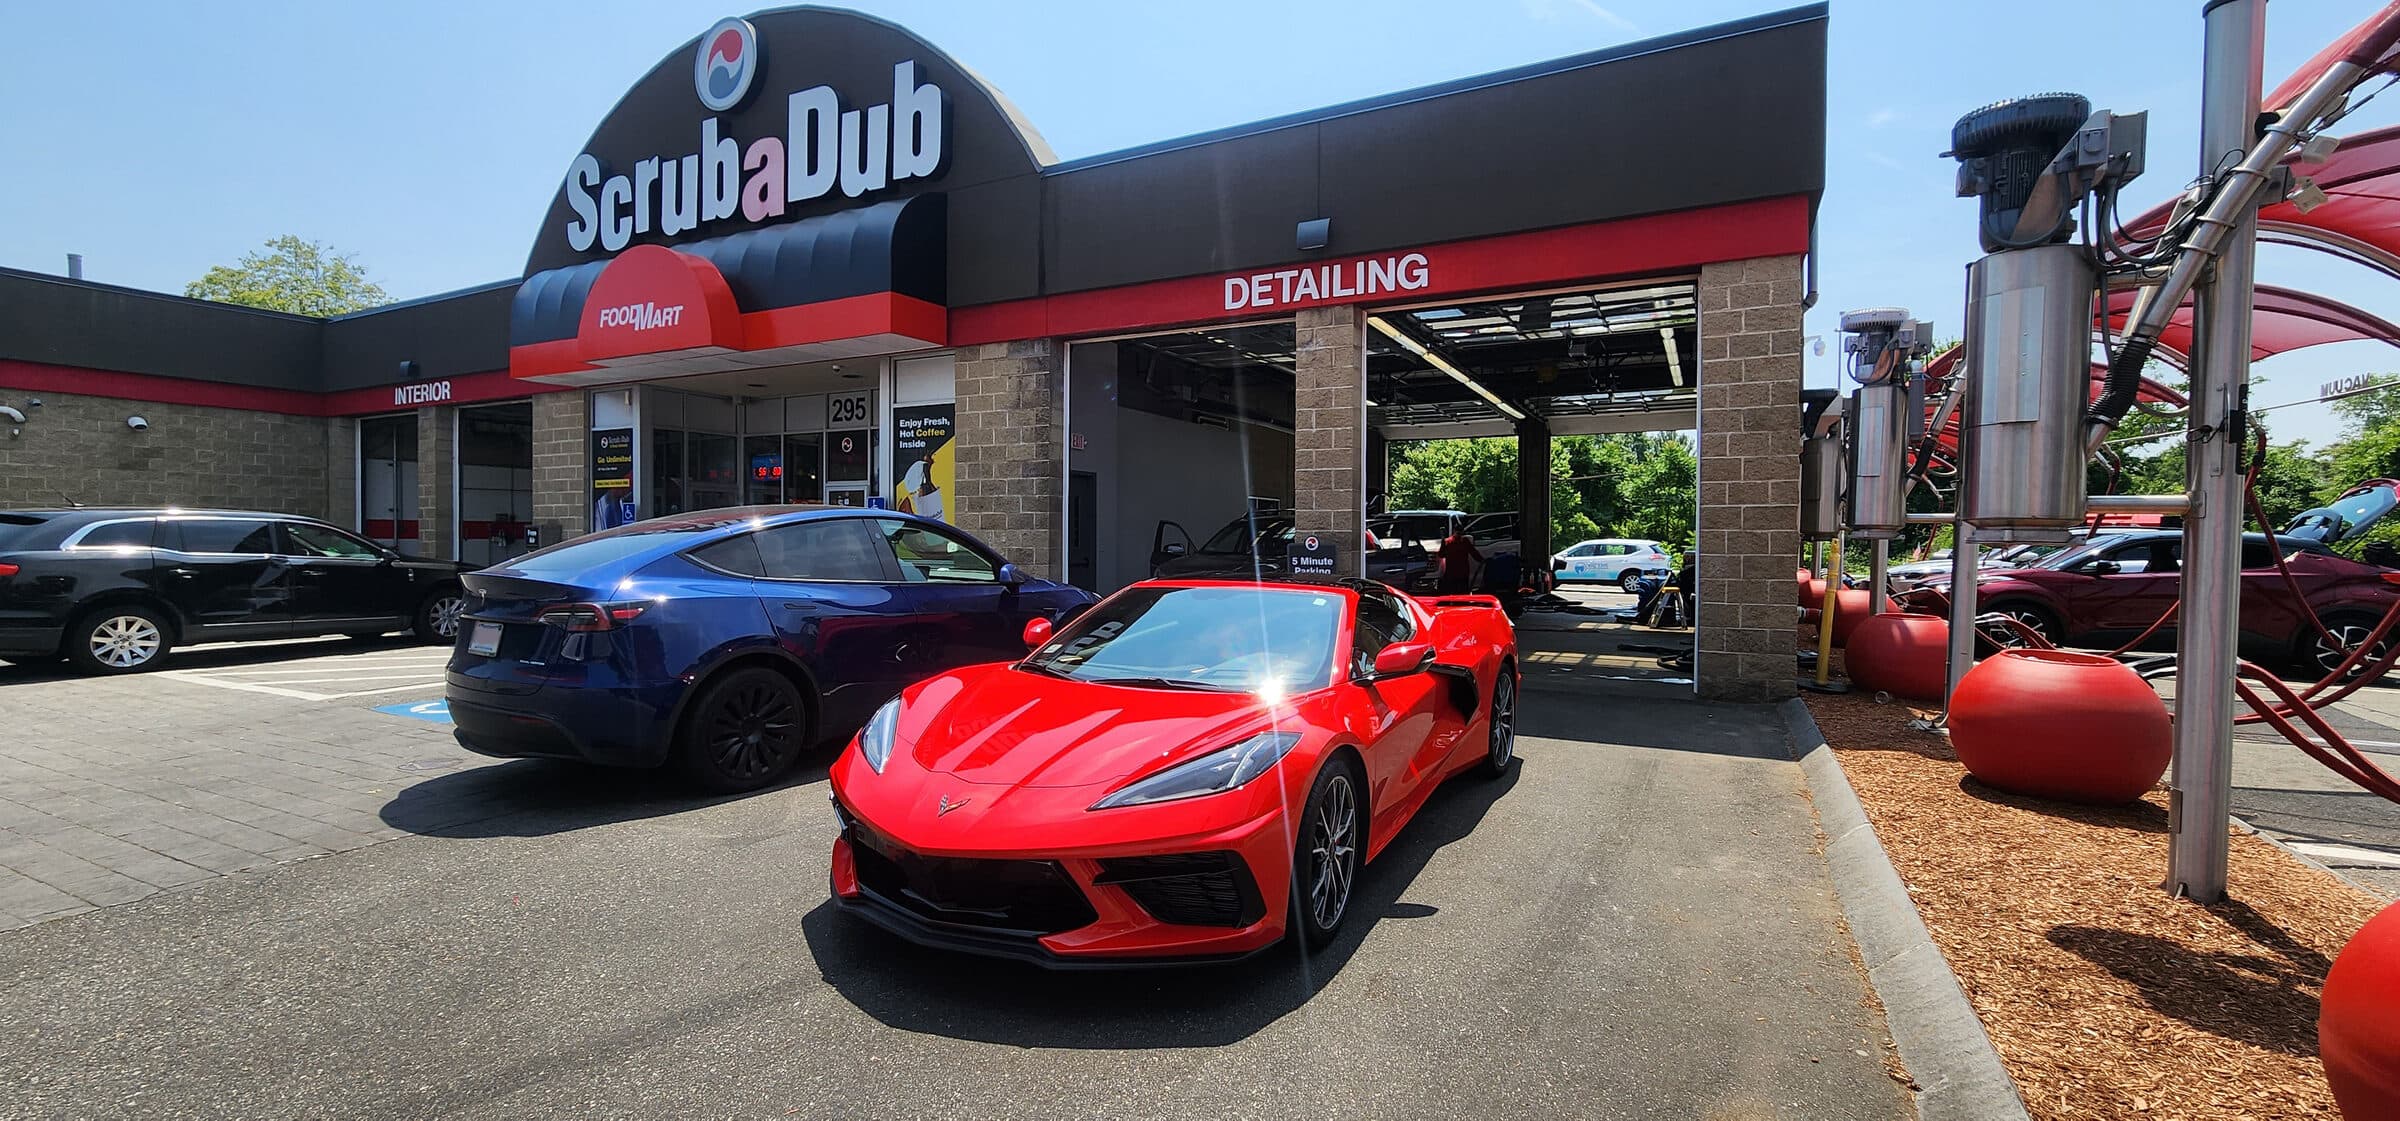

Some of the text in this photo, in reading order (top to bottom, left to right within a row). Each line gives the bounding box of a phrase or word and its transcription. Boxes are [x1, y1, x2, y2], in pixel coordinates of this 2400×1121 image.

[566, 59, 943, 252] ScrubaDub
[1224, 253, 1430, 311] DETAILING
[394, 380, 452, 406] INTERIOR
[831, 397, 867, 423] 295
[899, 416, 951, 429] Enjoy Fresh,
[899, 428, 946, 439] Hot Coffee
[899, 439, 926, 449] Inside
[1291, 556, 1334, 566] 5 Minute
